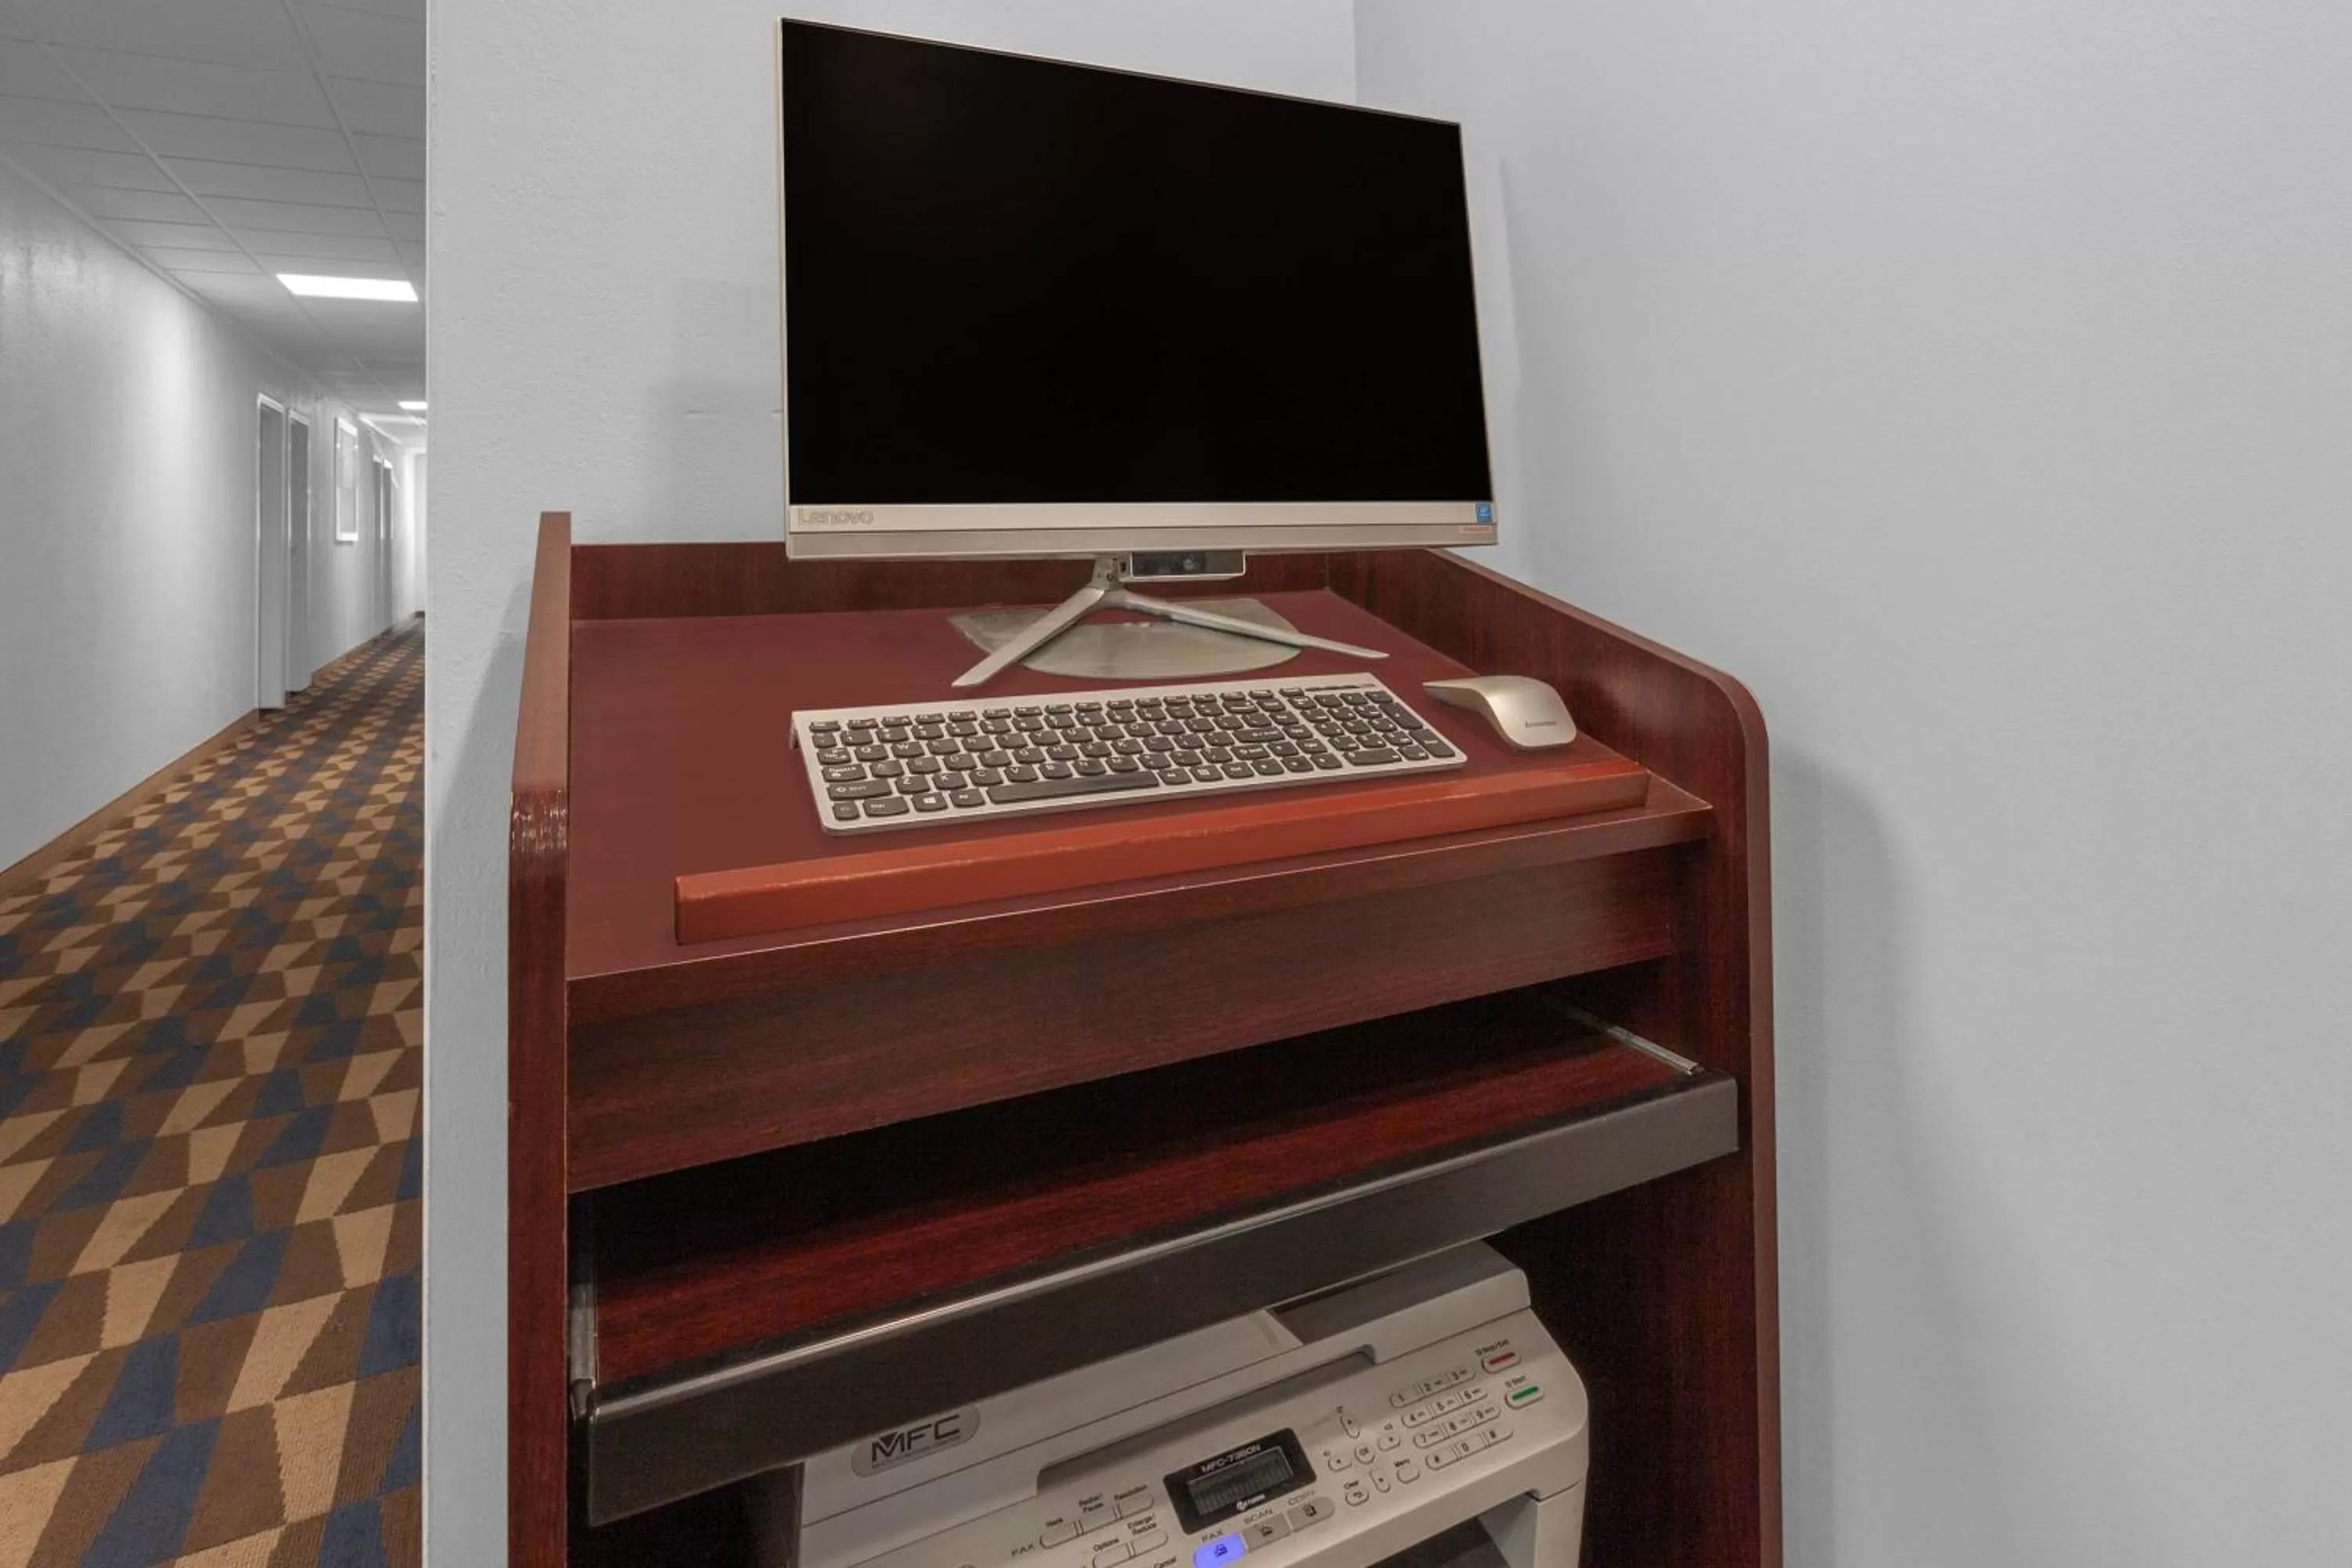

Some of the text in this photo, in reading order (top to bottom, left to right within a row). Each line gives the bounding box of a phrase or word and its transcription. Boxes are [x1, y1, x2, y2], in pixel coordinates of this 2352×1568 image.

[871, 1414, 960, 1462] MFC
[1243, 1508, 1273, 1525] SCAN
[1201, 1530, 1225, 1543] FAX
